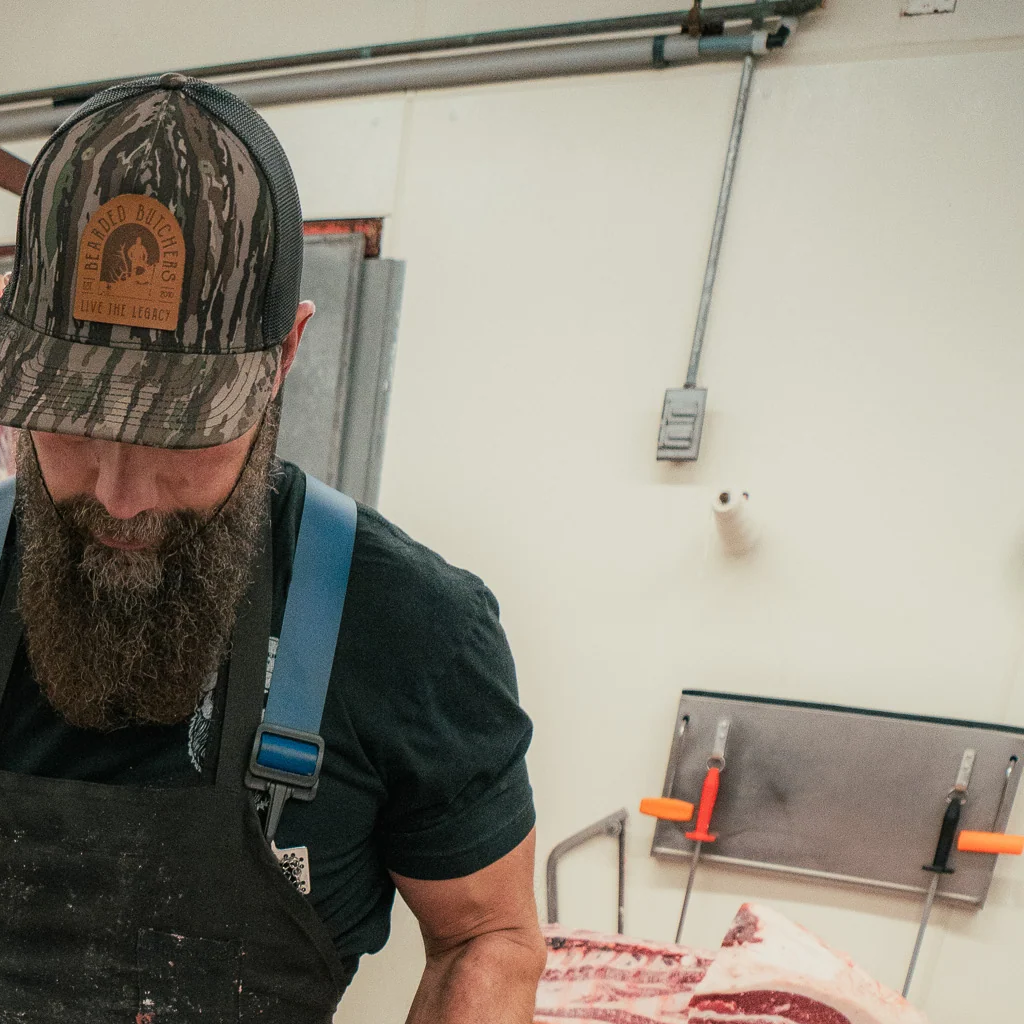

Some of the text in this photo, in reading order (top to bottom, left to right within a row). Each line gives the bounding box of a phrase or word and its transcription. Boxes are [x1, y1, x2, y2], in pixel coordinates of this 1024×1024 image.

[84, 204, 179, 281] BEARDED BUTCHERS
[80, 300, 171, 321] LIVE THE LEGACY
